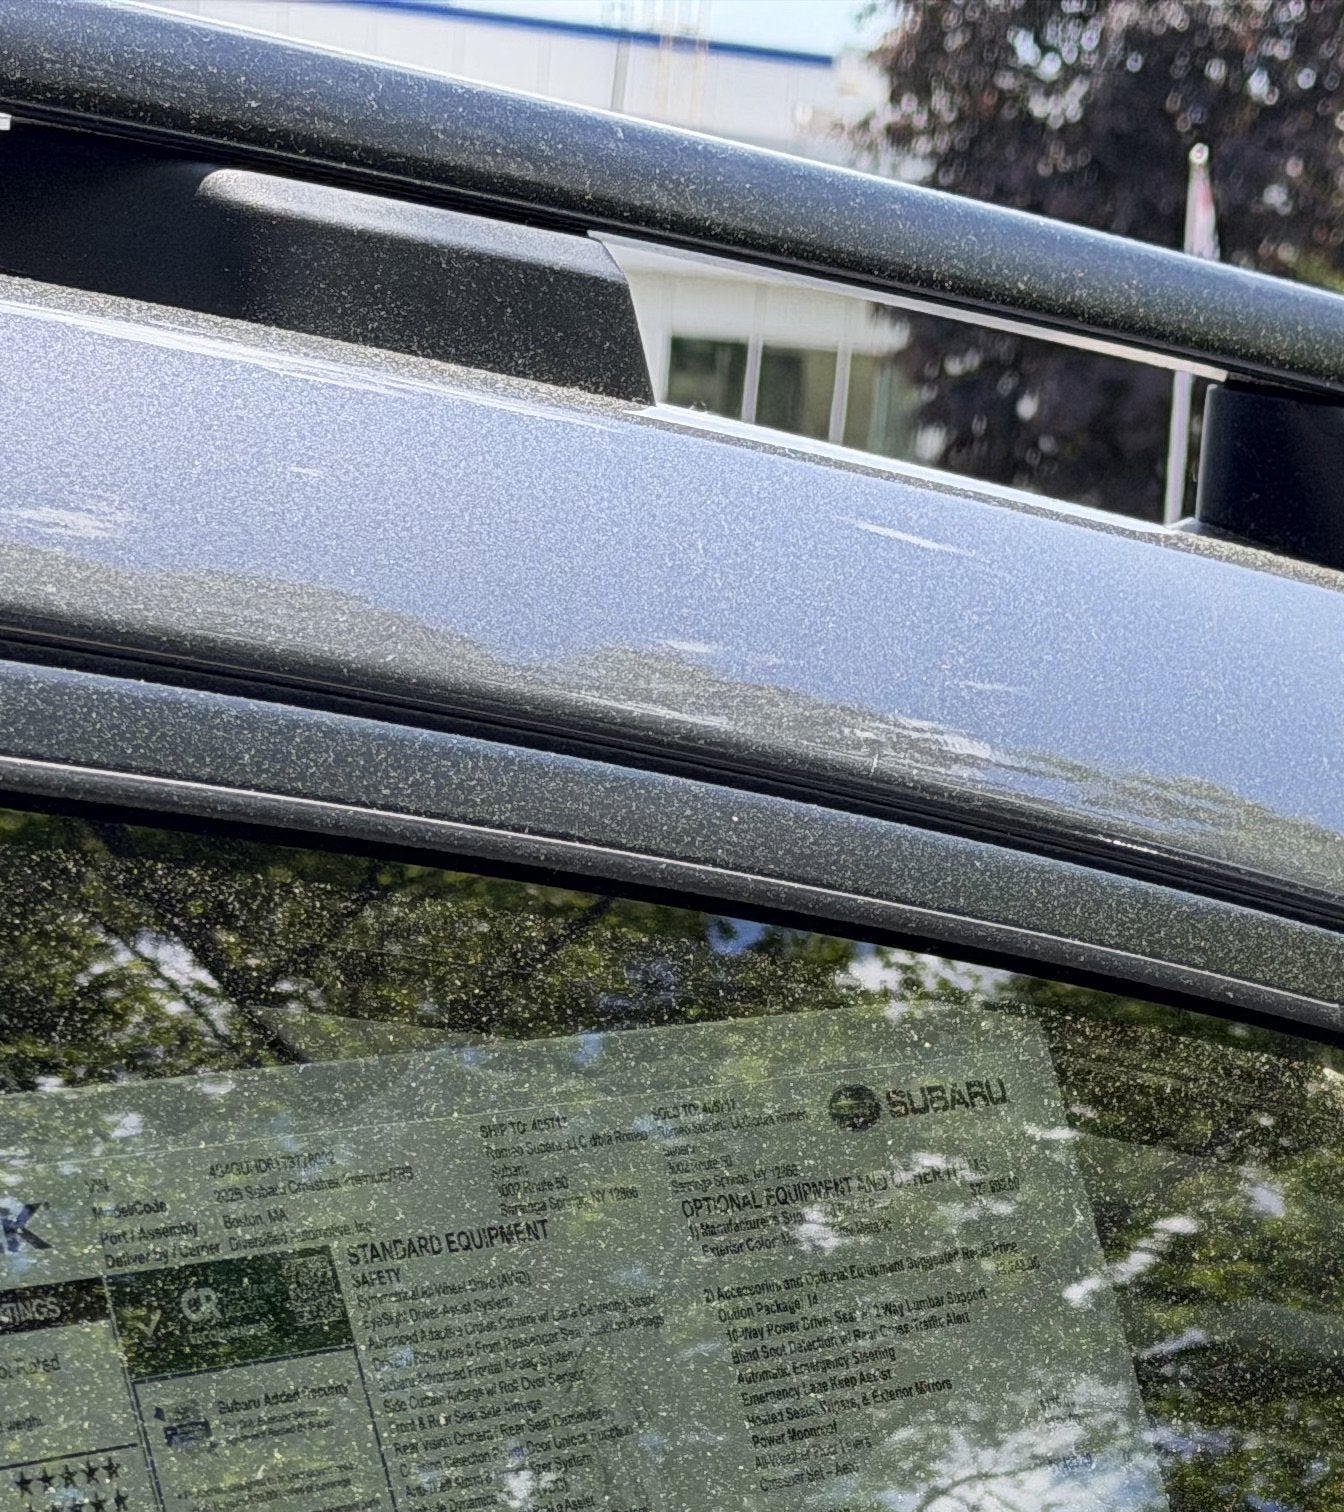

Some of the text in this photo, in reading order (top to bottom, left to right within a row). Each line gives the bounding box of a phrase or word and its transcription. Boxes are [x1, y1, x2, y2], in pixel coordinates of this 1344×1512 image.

[884, 1079, 1009, 1116] SUBARU
[267, 1208, 288, 1224] MA
[680, 1190, 763, 1218] OPTIONAL
[343, 1219, 552, 1266] STANDARD EQUIPMENT
[350, 1268, 403, 1288] SAFETY
